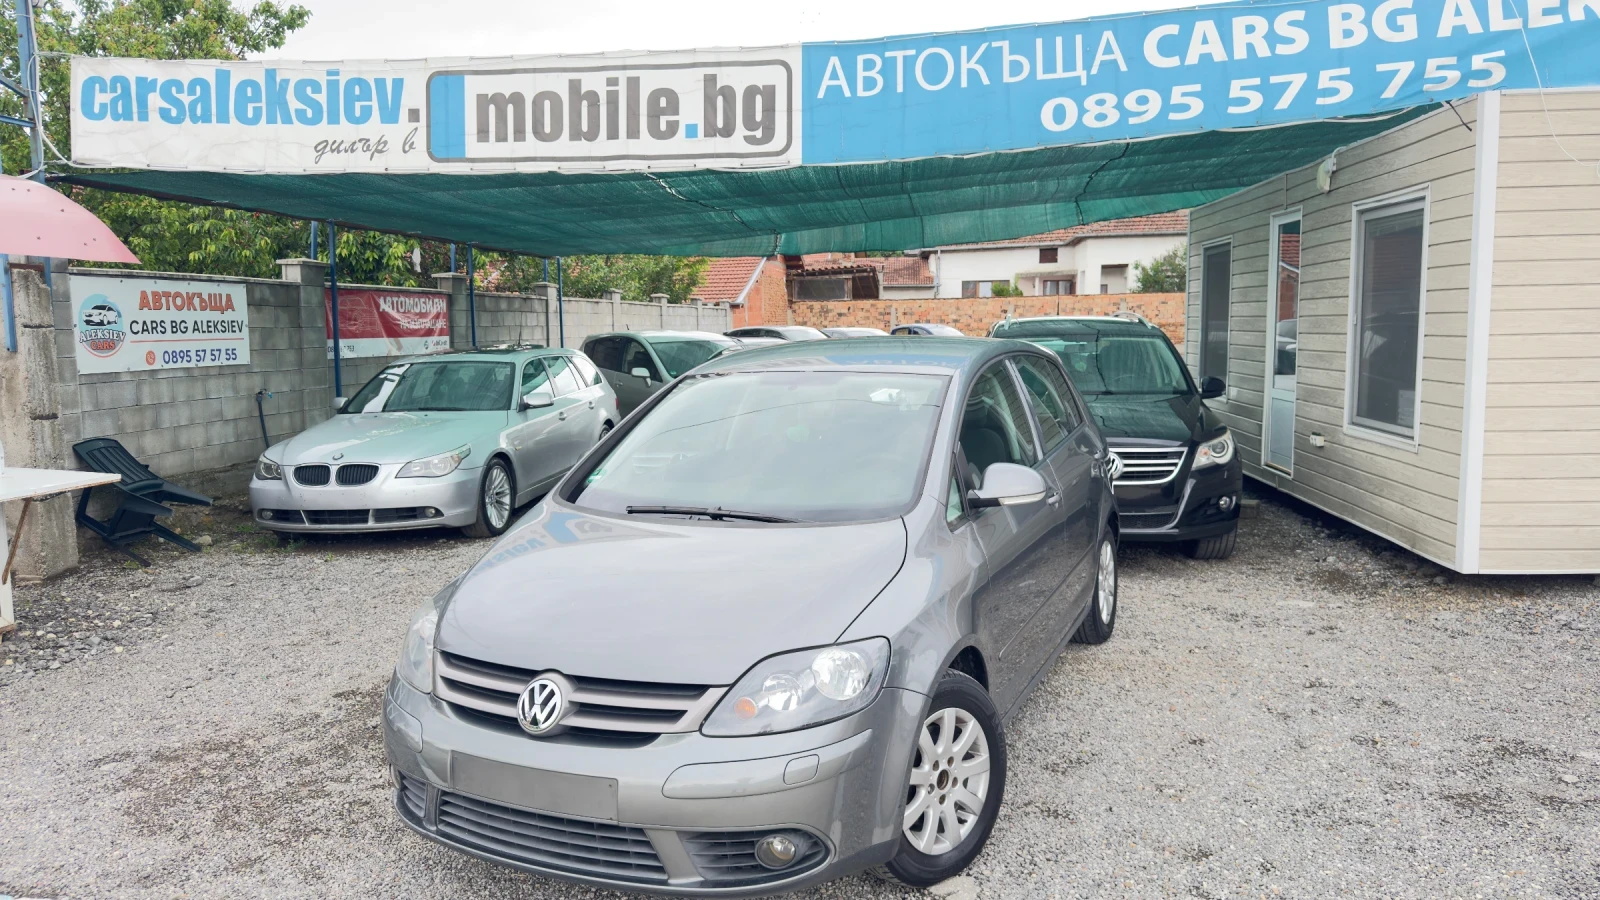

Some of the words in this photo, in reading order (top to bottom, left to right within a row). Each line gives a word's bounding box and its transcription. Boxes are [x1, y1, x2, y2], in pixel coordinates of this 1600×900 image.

[818, 31, 1128, 99] АВТОКЪЩА
[1144, 10, 1310, 68] CARS
[1328, 0, 1419, 49] BG
[1041, 84, 1204, 132] 0895
[1228, 68, 1354, 113] 575
[1376, 49, 1506, 99] 755
[476, 74, 777, 145] mobile.bg
[314, 135, 389, 164] дилър
[402, 127, 418, 154] в
[139, 290, 236, 314] АВТОКЪЩА
[79, 328, 126, 343] ALEKSIEV
[130, 320, 167, 335] CARS
[171, 320, 188, 334] BG
[192, 318, 244, 334] ALEKSIEV
[90, 340, 116, 350] CARS
[163, 350, 192, 364] 0895
[195, 349, 207, 363] 57
[210, 349, 222, 362] 57
[225, 348, 238, 361] 55
